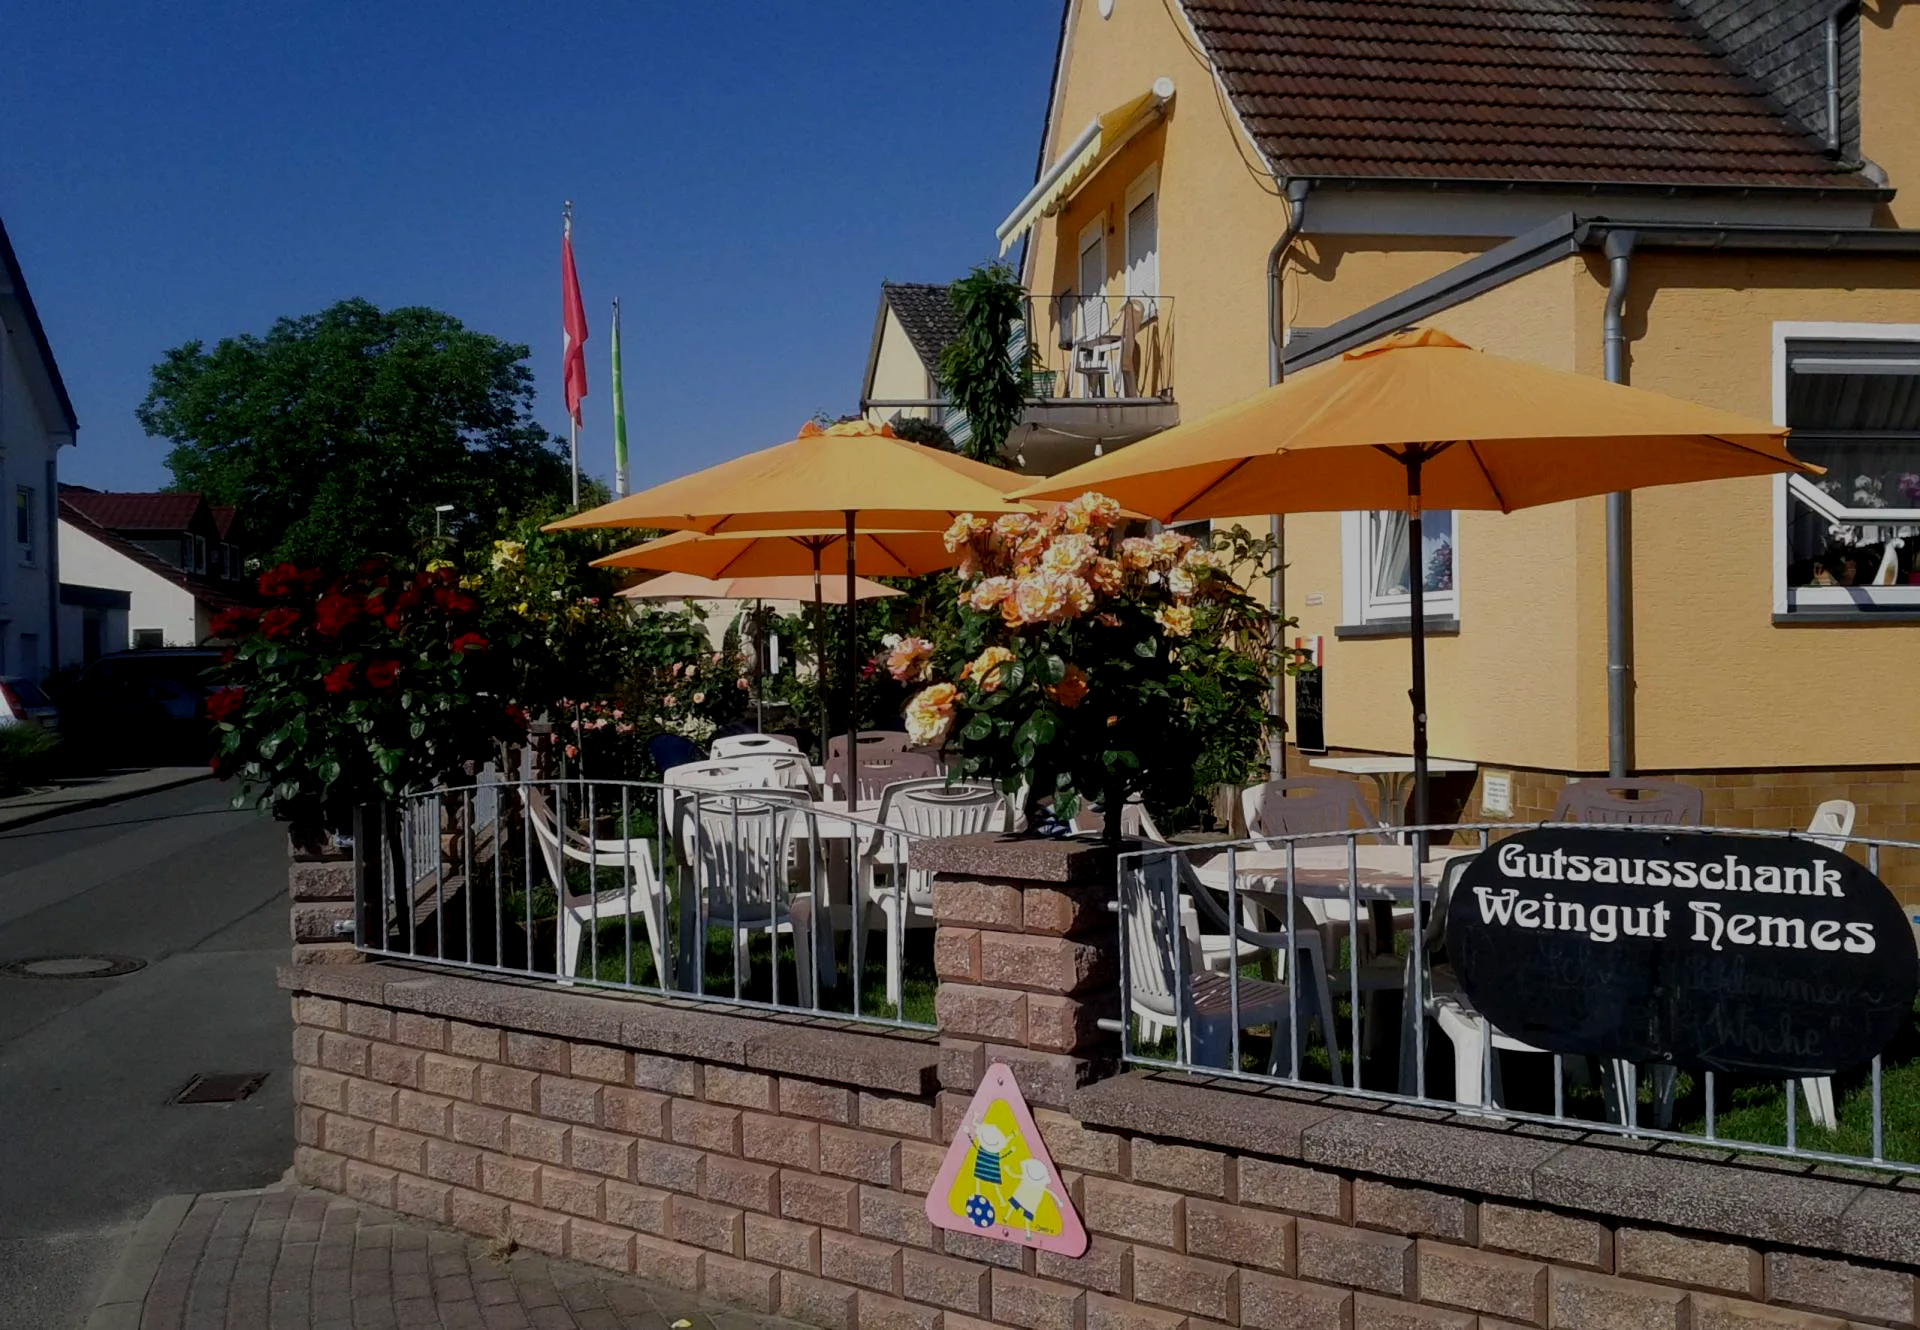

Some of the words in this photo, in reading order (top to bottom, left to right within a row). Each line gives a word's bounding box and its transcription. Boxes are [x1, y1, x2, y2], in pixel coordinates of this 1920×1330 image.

[1498, 843, 1846, 898] Gutsausschank
[1472, 886, 1671, 943] Weingut
[1687, 900, 1877, 955] Hemes
